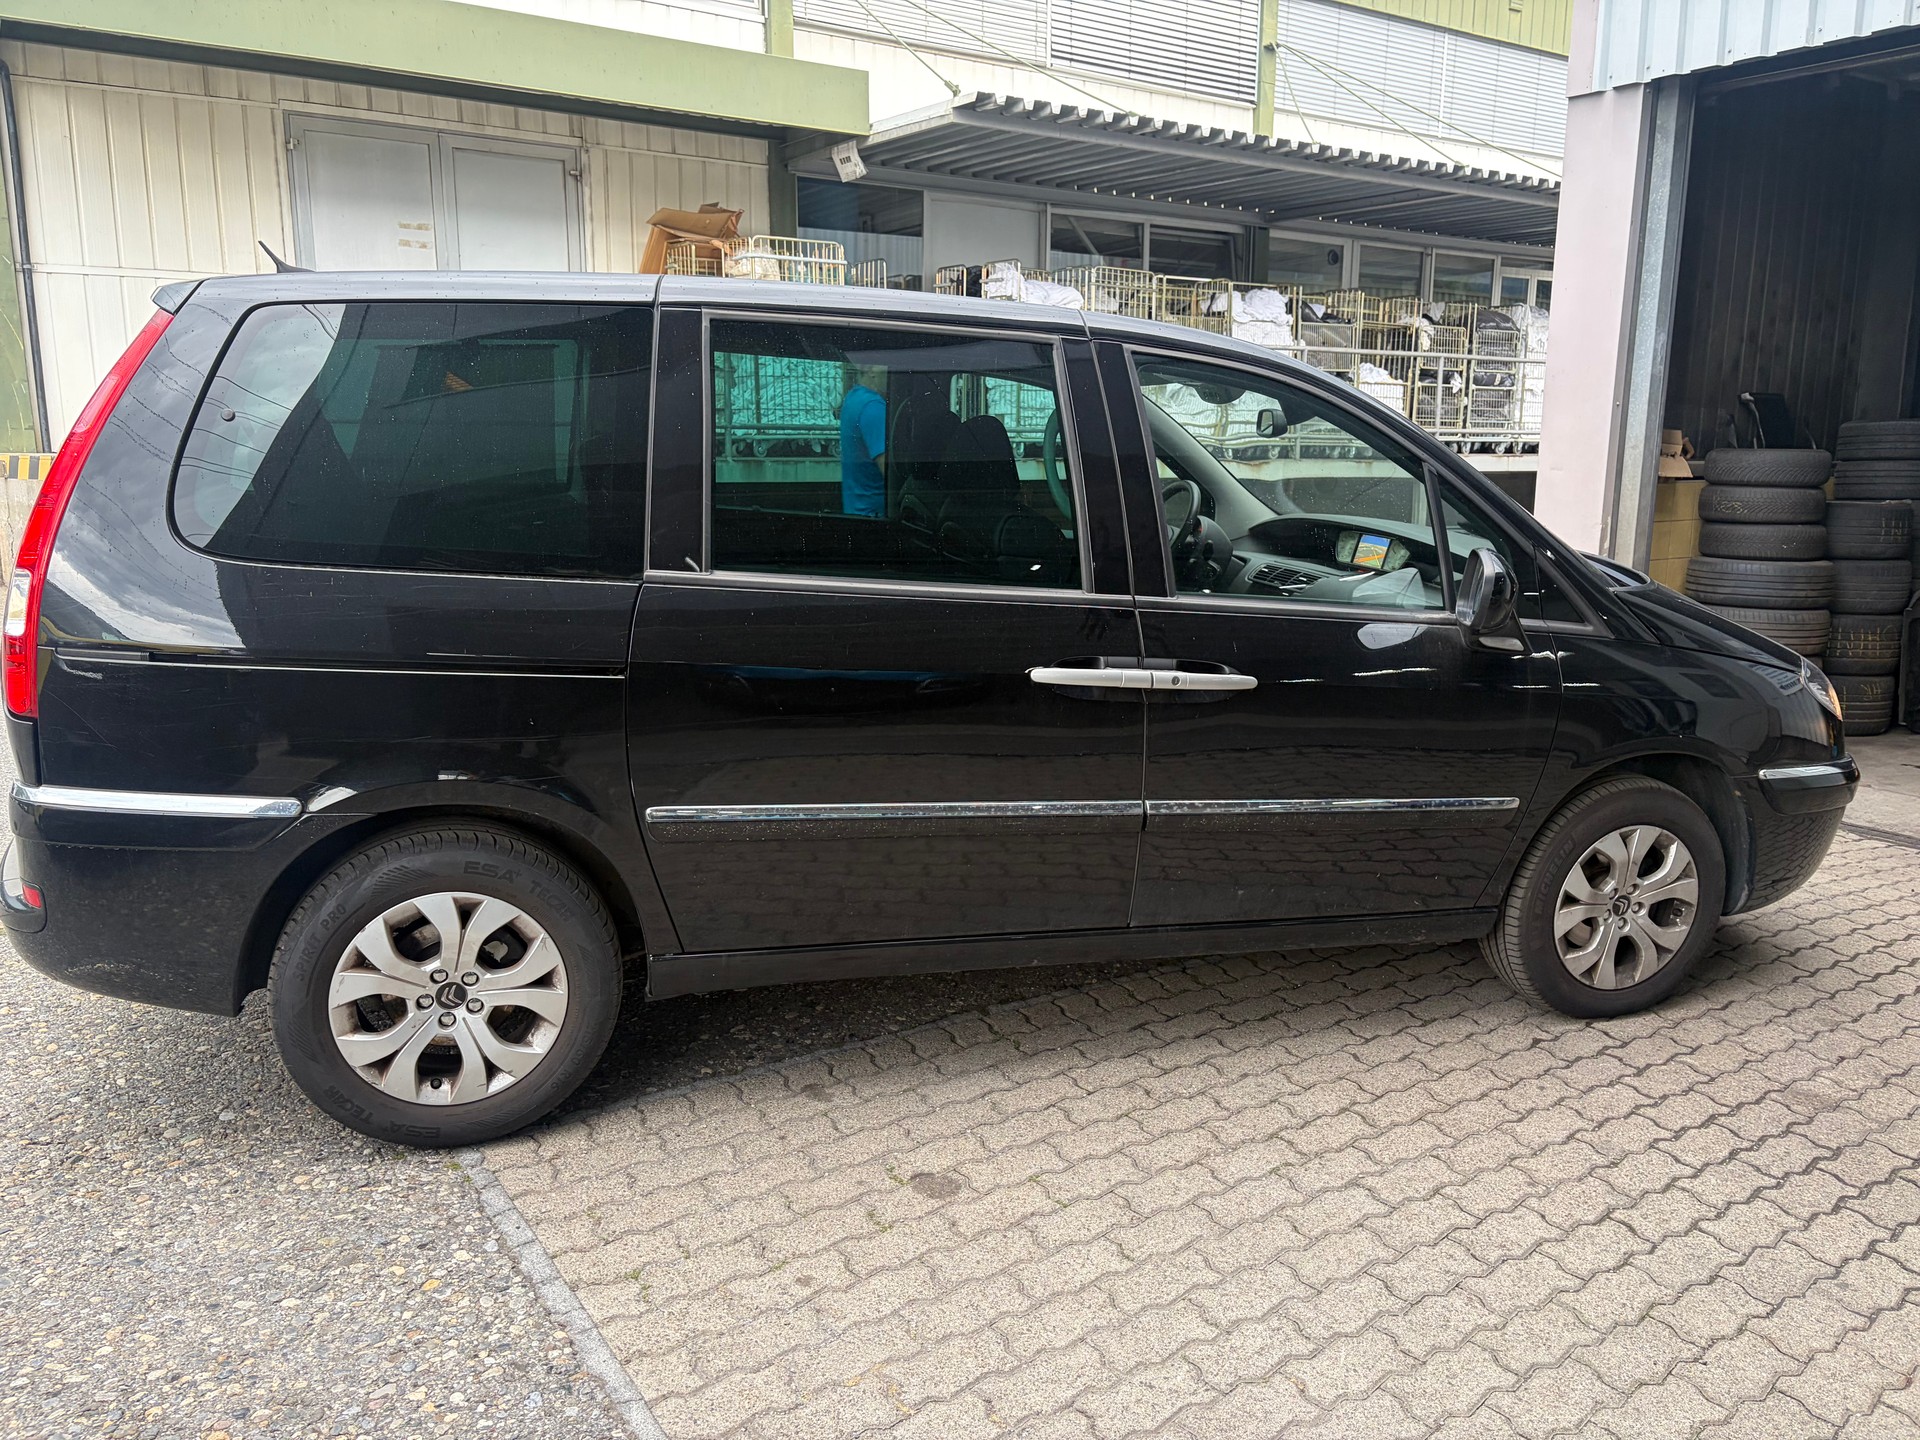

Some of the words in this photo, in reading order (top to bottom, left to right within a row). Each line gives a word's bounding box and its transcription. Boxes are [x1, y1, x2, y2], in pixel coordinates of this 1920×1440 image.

[1534, 840, 1573, 914] MICHELIN
[292, 931, 320, 981] SPIRIT
[320, 903, 346, 931] PRO
